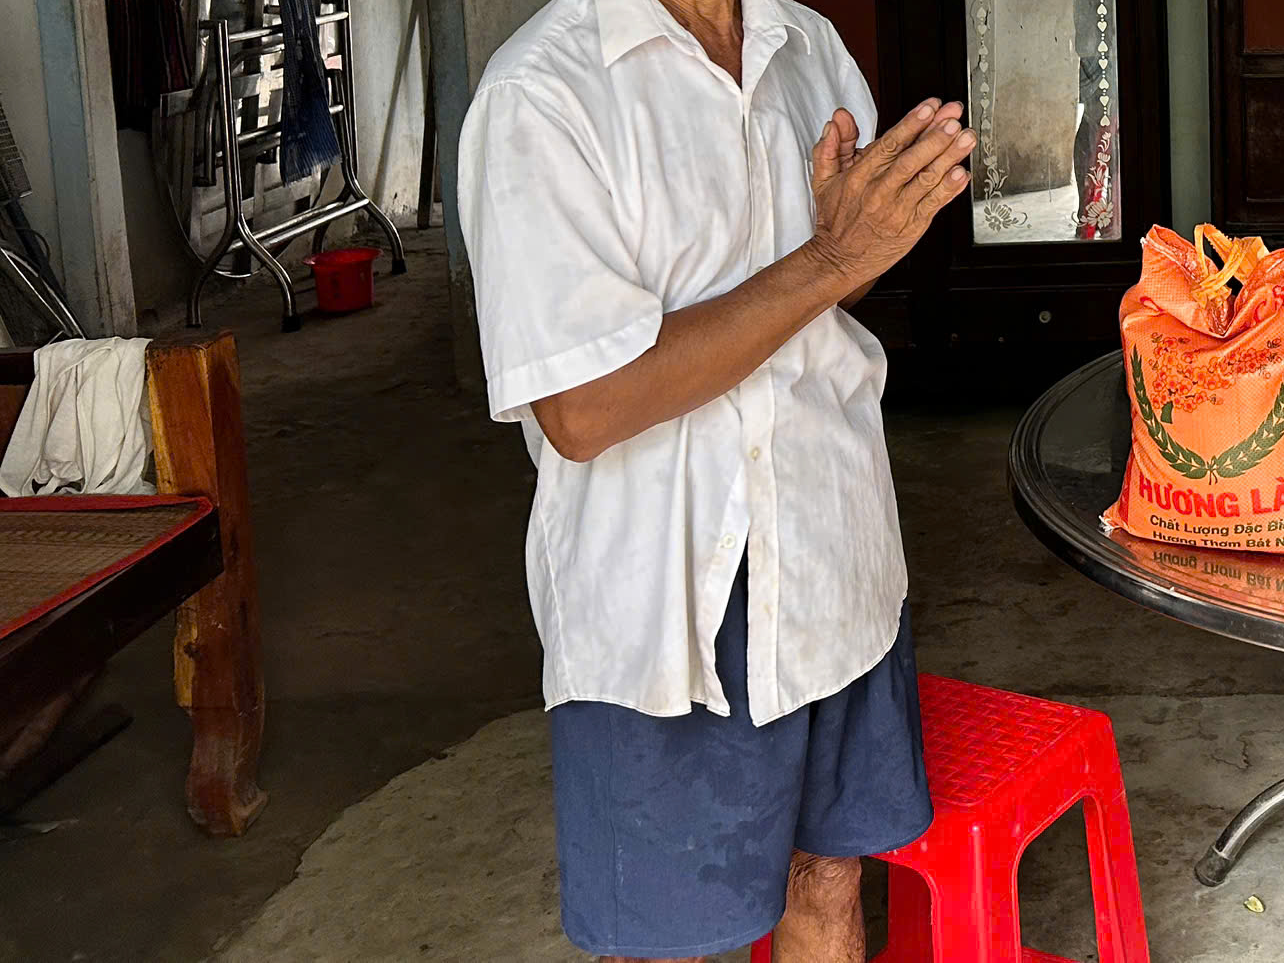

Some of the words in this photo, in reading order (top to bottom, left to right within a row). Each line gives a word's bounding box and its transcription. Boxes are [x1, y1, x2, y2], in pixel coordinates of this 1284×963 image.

[1139, 476, 1240, 517] HƯƠNG
[1150, 514, 1180, 532] Chất
[1184, 523, 1229, 537] Lượng
[1234, 524, 1262, 537] Đặc
[1153, 530, 1197, 546] Hương
[1201, 538, 1241, 548] Thơm
[1246, 538, 1270, 548] Bát
